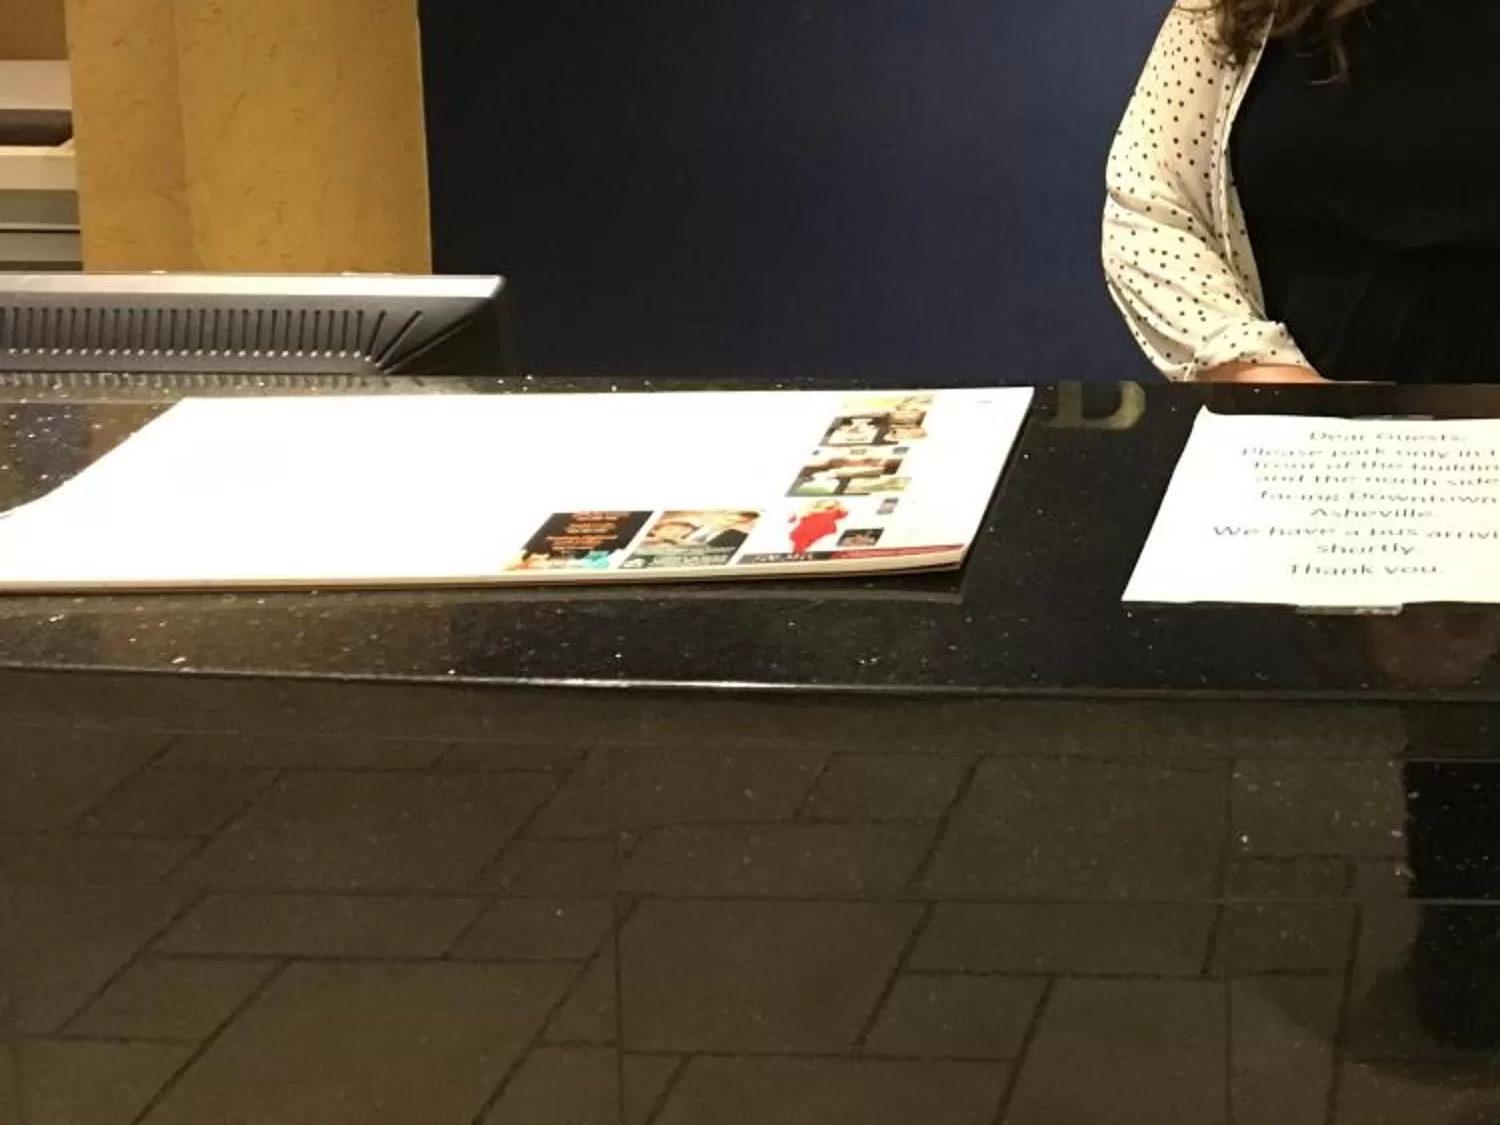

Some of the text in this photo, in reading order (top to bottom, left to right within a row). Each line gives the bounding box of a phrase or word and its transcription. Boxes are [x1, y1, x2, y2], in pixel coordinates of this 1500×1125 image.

[1241, 446, 1323, 457] Please
[1331, 446, 1385, 458] park
[1396, 448, 1448, 460] only
[1458, 449, 1480, 458] in
[1326, 460, 1350, 470] of
[1361, 460, 1403, 469] the
[1255, 474, 1304, 483] and
[1314, 475, 1357, 484] the
[1349, 491, 1497, 504] Downtown
[1212, 526, 1260, 537] We
[1268, 526, 1337, 537] have
[1369, 527, 1419, 537] bus
[1290, 562, 1374, 576] Thank
